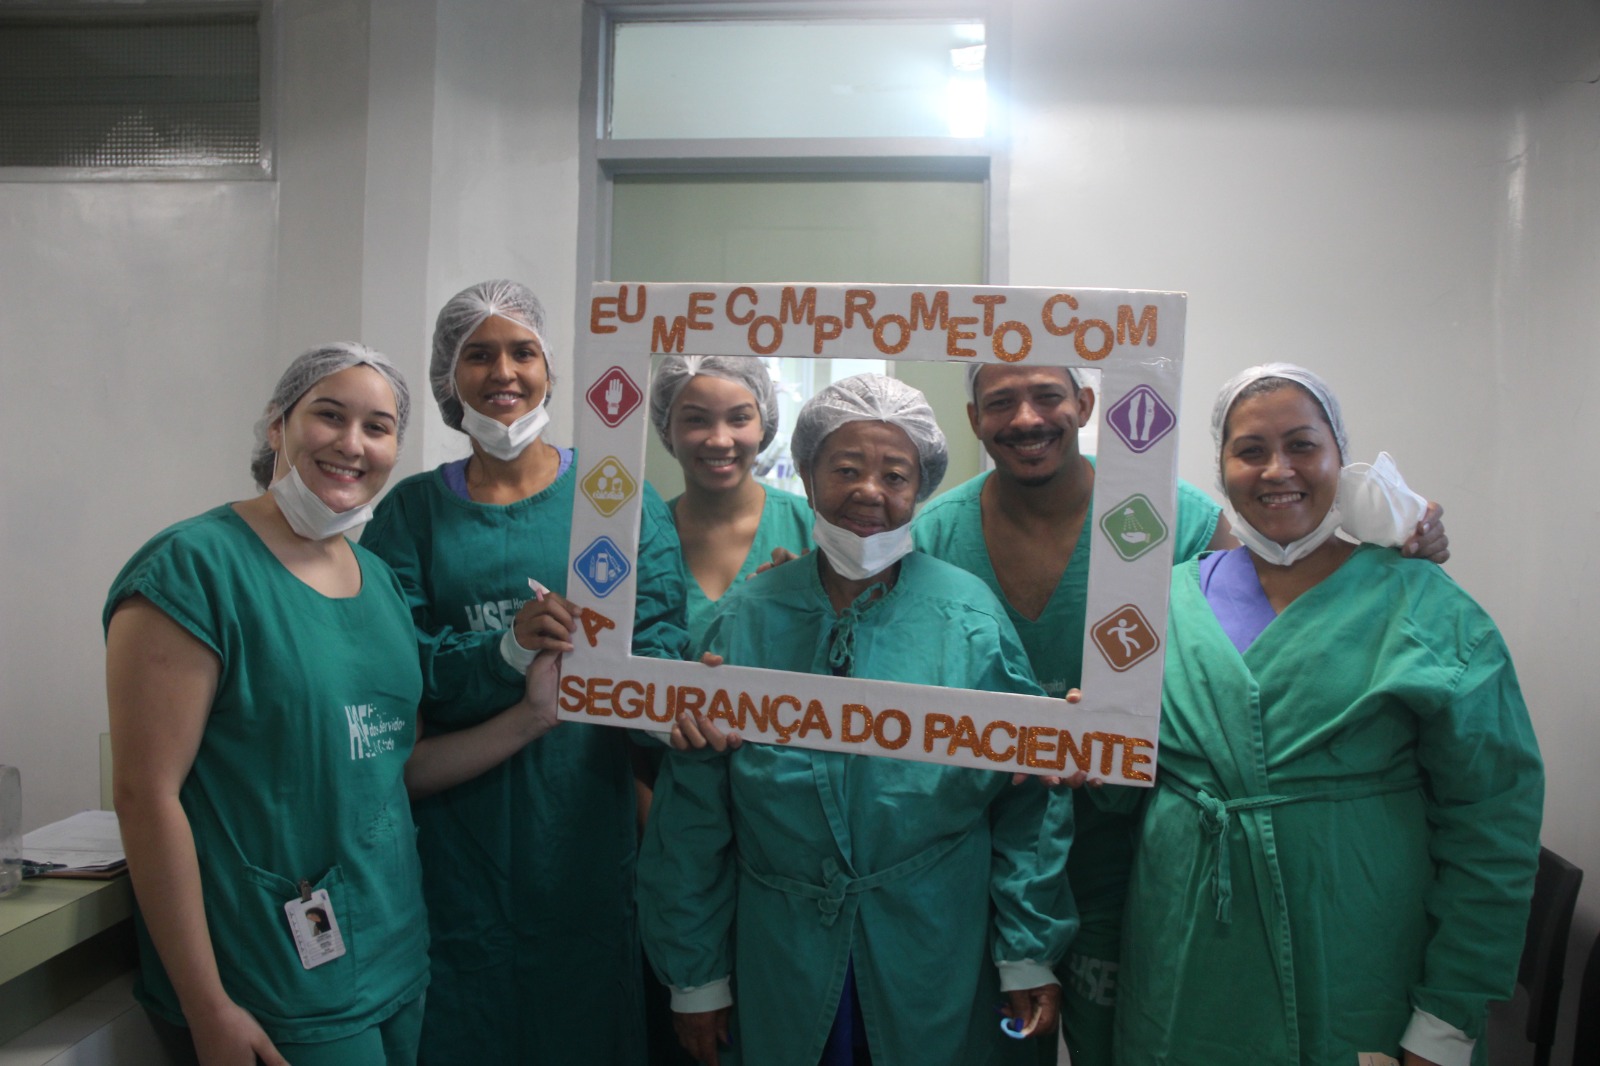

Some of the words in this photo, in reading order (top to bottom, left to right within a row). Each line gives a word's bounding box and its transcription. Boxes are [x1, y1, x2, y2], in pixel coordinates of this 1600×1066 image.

[591, 285, 646, 334] EU
[651, 292, 716, 353] ME
[725, 286, 1032, 362] COMPROMETO
[1042, 293, 1157, 361] COM
[580, 607, 615, 647] A
[559, 675, 832, 744] SEGURANÇA
[841, 703, 911, 750] DO
[924, 713, 1154, 782] PACIENTE
